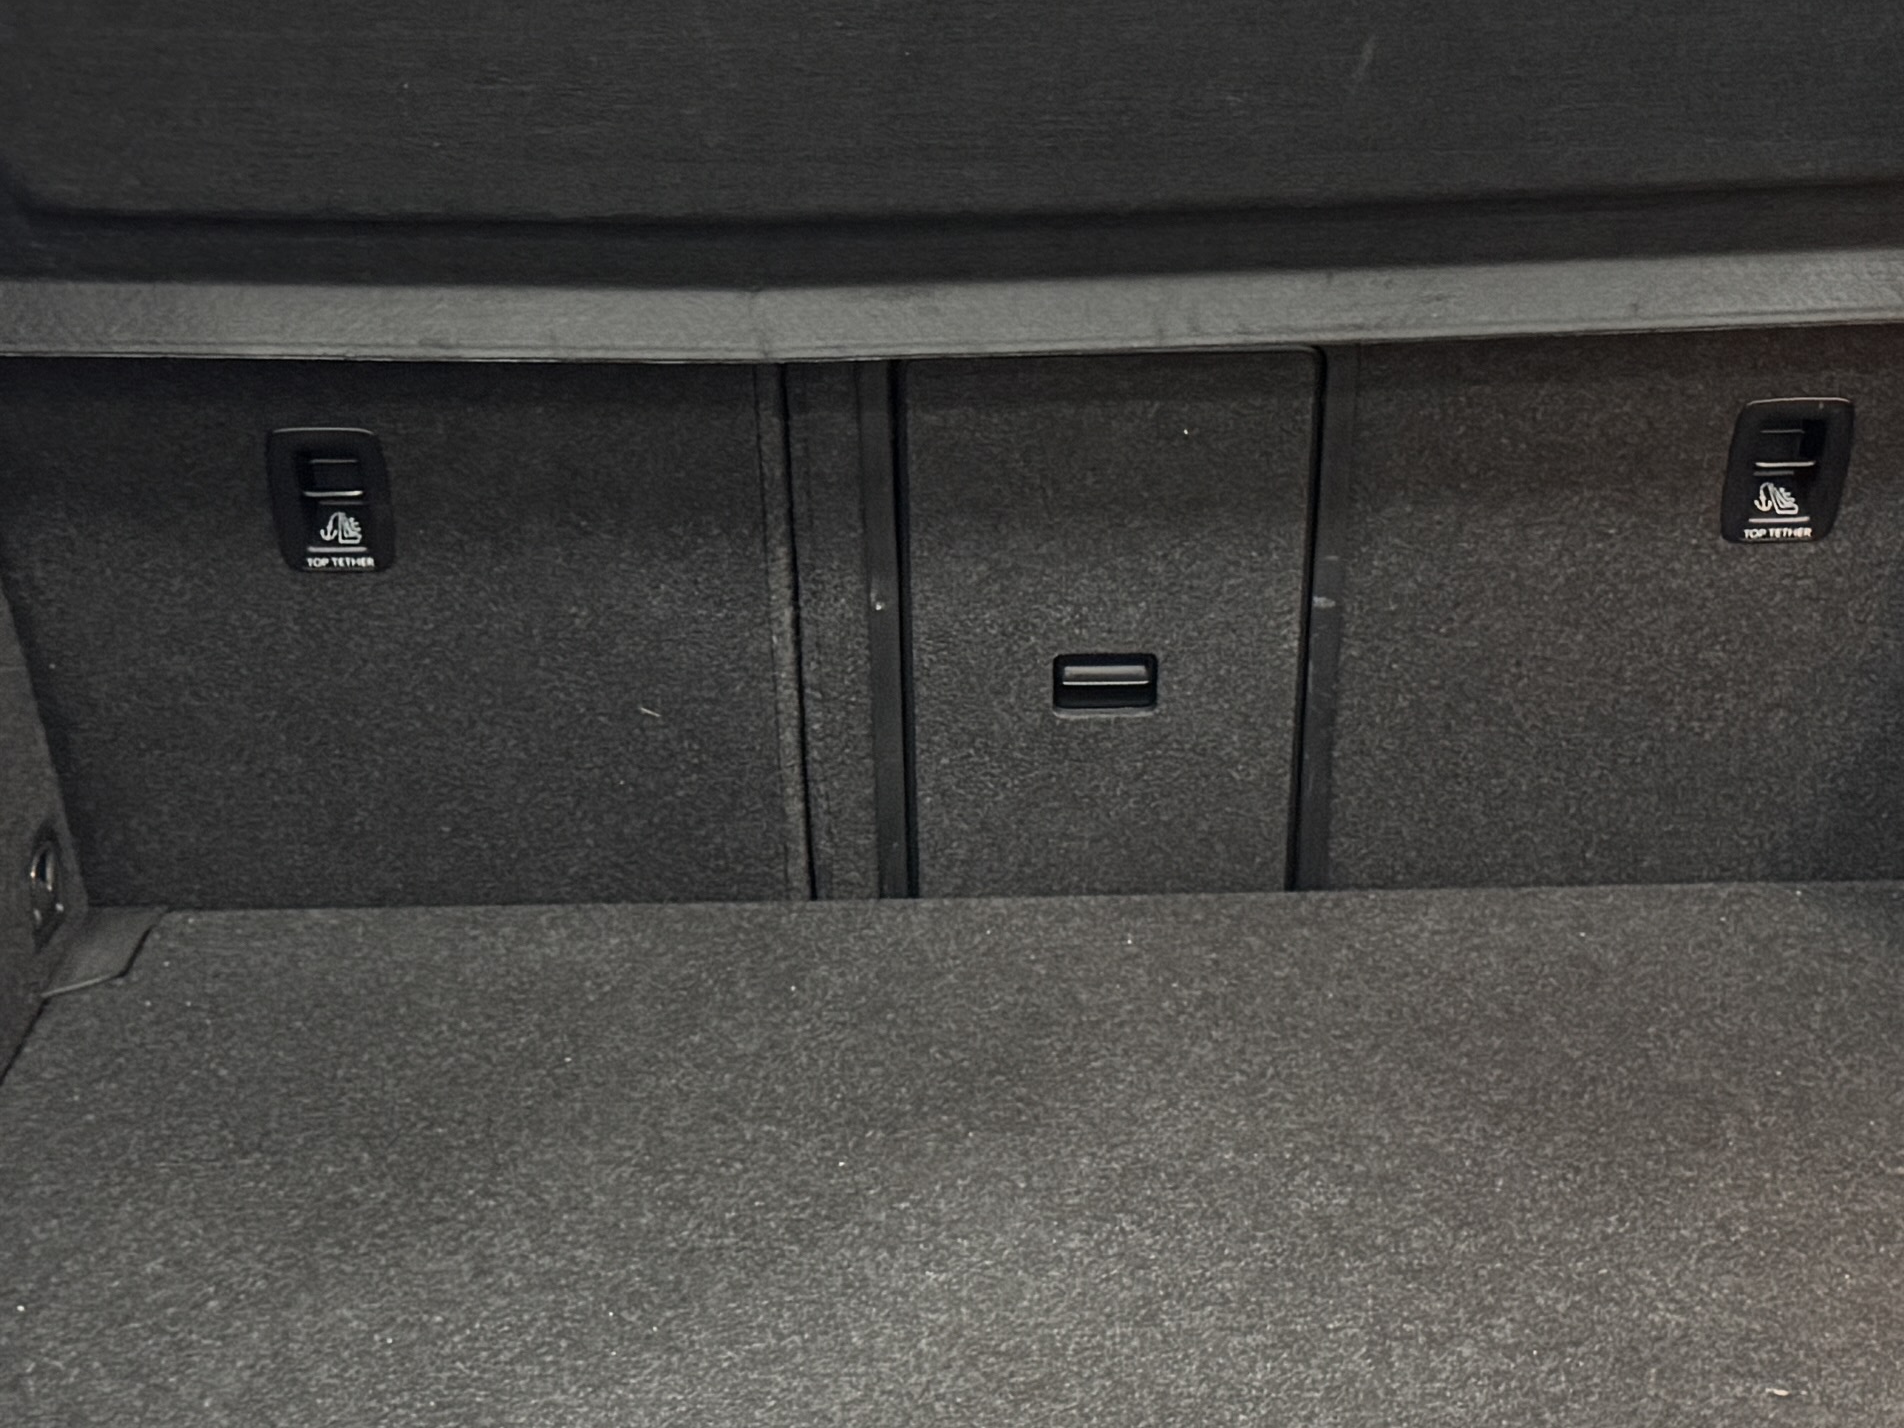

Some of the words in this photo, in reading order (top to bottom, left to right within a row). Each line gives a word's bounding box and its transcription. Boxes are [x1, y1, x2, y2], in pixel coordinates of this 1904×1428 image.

[1743, 528, 1767, 539] TOP
[1769, 526, 1813, 539] TETHER
[306, 557, 329, 568] TOP
[332, 556, 375, 568] TETHER
